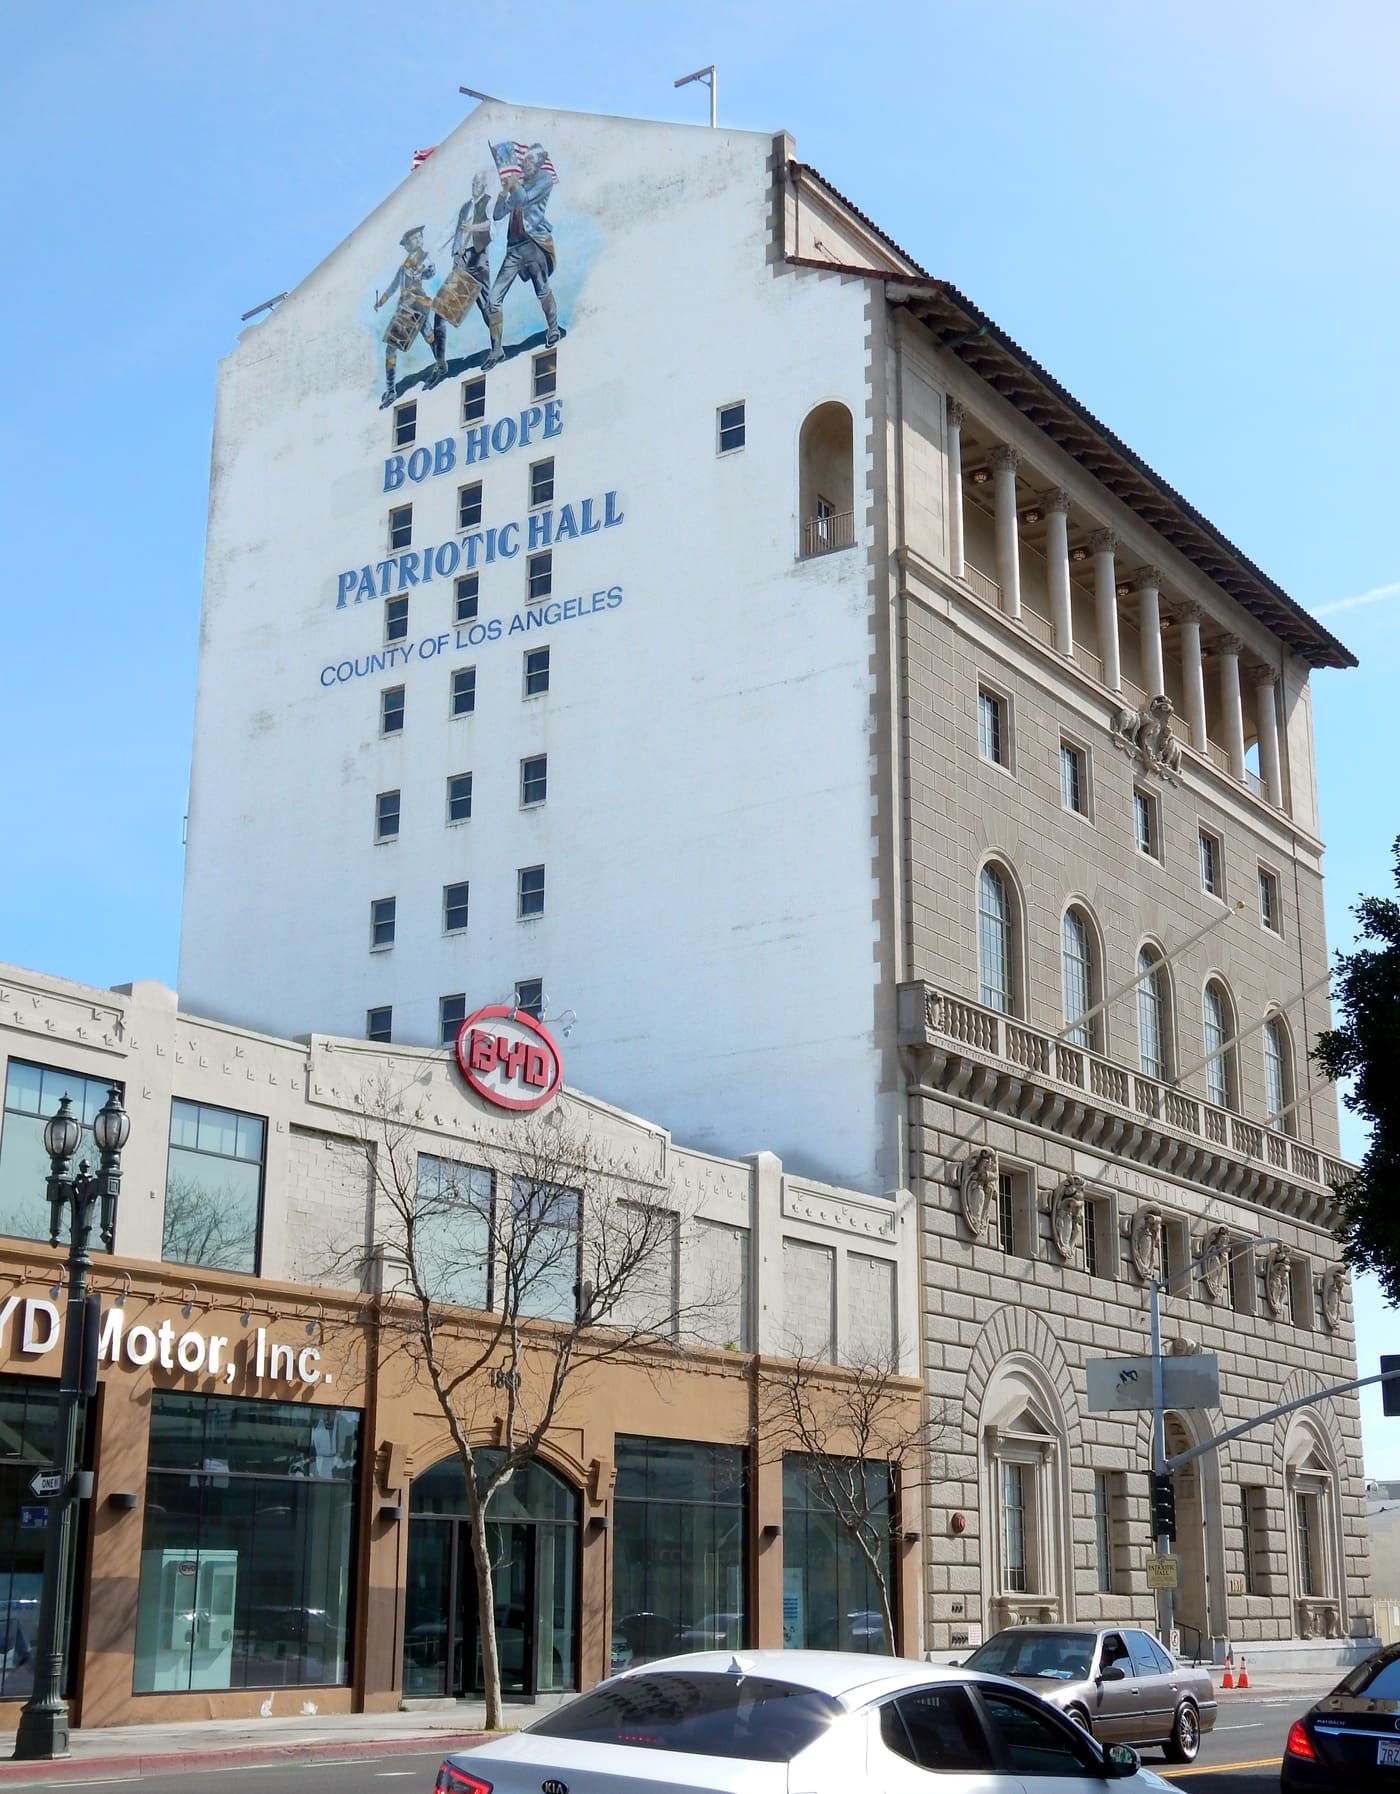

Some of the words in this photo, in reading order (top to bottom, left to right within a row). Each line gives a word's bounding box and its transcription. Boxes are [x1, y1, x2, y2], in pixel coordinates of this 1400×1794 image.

[383, 436, 456, 493] BOB
[465, 399, 563, 465] HOPE
[336, 522, 520, 610] PATRIOTIC
[527, 491, 624, 551] HALL
[320, 643, 415, 687] COUNTY
[418, 633, 450, 660] OF
[456, 619, 502, 650] LOS
[508, 585, 624, 636] ANGELES
[470, 1028, 551, 1088] BYD
[1103, 1164, 1188, 1207] PATRIOTIC
[1204, 1199, 1237, 1223] HALL
[256, 1327, 332, 1384] Inc.
[545, 1781, 564, 1794] KIA
